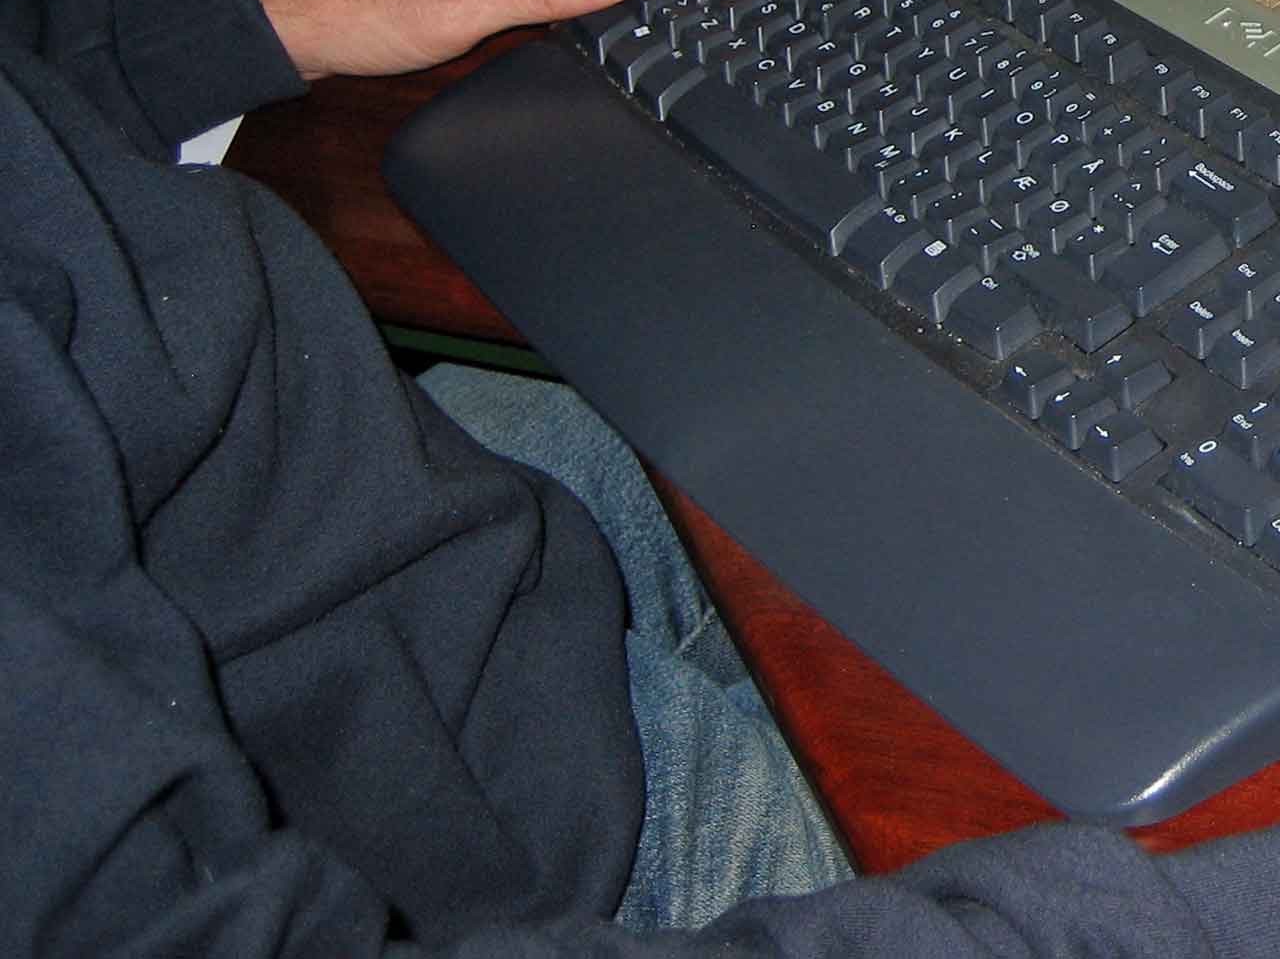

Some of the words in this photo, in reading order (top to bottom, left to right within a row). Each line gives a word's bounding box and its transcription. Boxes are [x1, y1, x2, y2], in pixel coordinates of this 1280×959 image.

[761, 3, 777, 14] S
[901, 0, 914, 9] 5
[854, 6, 871, 20] R
[1070, 12, 1084, 24] F7
[701, 18, 719, 29] Z
[789, 22, 806, 34] D
[932, 18, 944, 28] 6
[886, 26, 903, 38] T
[729, 38, 746, 50] X
[818, 41, 836, 54] F
[964, 38, 977, 48] 7
[919, 47, 935, 59] Y
[758, 59, 776, 70] C
[850, 63, 867, 76] G
[997, 60, 1009, 70] 8
[949, 68, 967, 80] U
[789, 79, 806, 89] V
[1031, 81, 1044, 90] 9
[880, 84, 898, 97] H
[1192, 85, 1210, 99] F10
[817, 100, 835, 113] B
[912, 107, 929, 116] J
[1065, 103, 1079, 113] 0
[1230, 107, 1247, 121] F11
[848, 122, 867, 135] N
[945, 128, 963, 141] K
[1051, 134, 1069, 144] P
[880, 145, 901, 159] M
[978, 151, 992, 164] L
[1082, 159, 1104, 174] Å
[1013, 175, 1037, 190] Æ
[1194, 162, 1236, 191] Backspace
[1050, 200, 1071, 213] Ø
[1238, 263, 1256, 277] End
[1252, 402, 1267, 413] 1
[1232, 414, 1254, 430] End
[1199, 440, 1217, 453] 0
